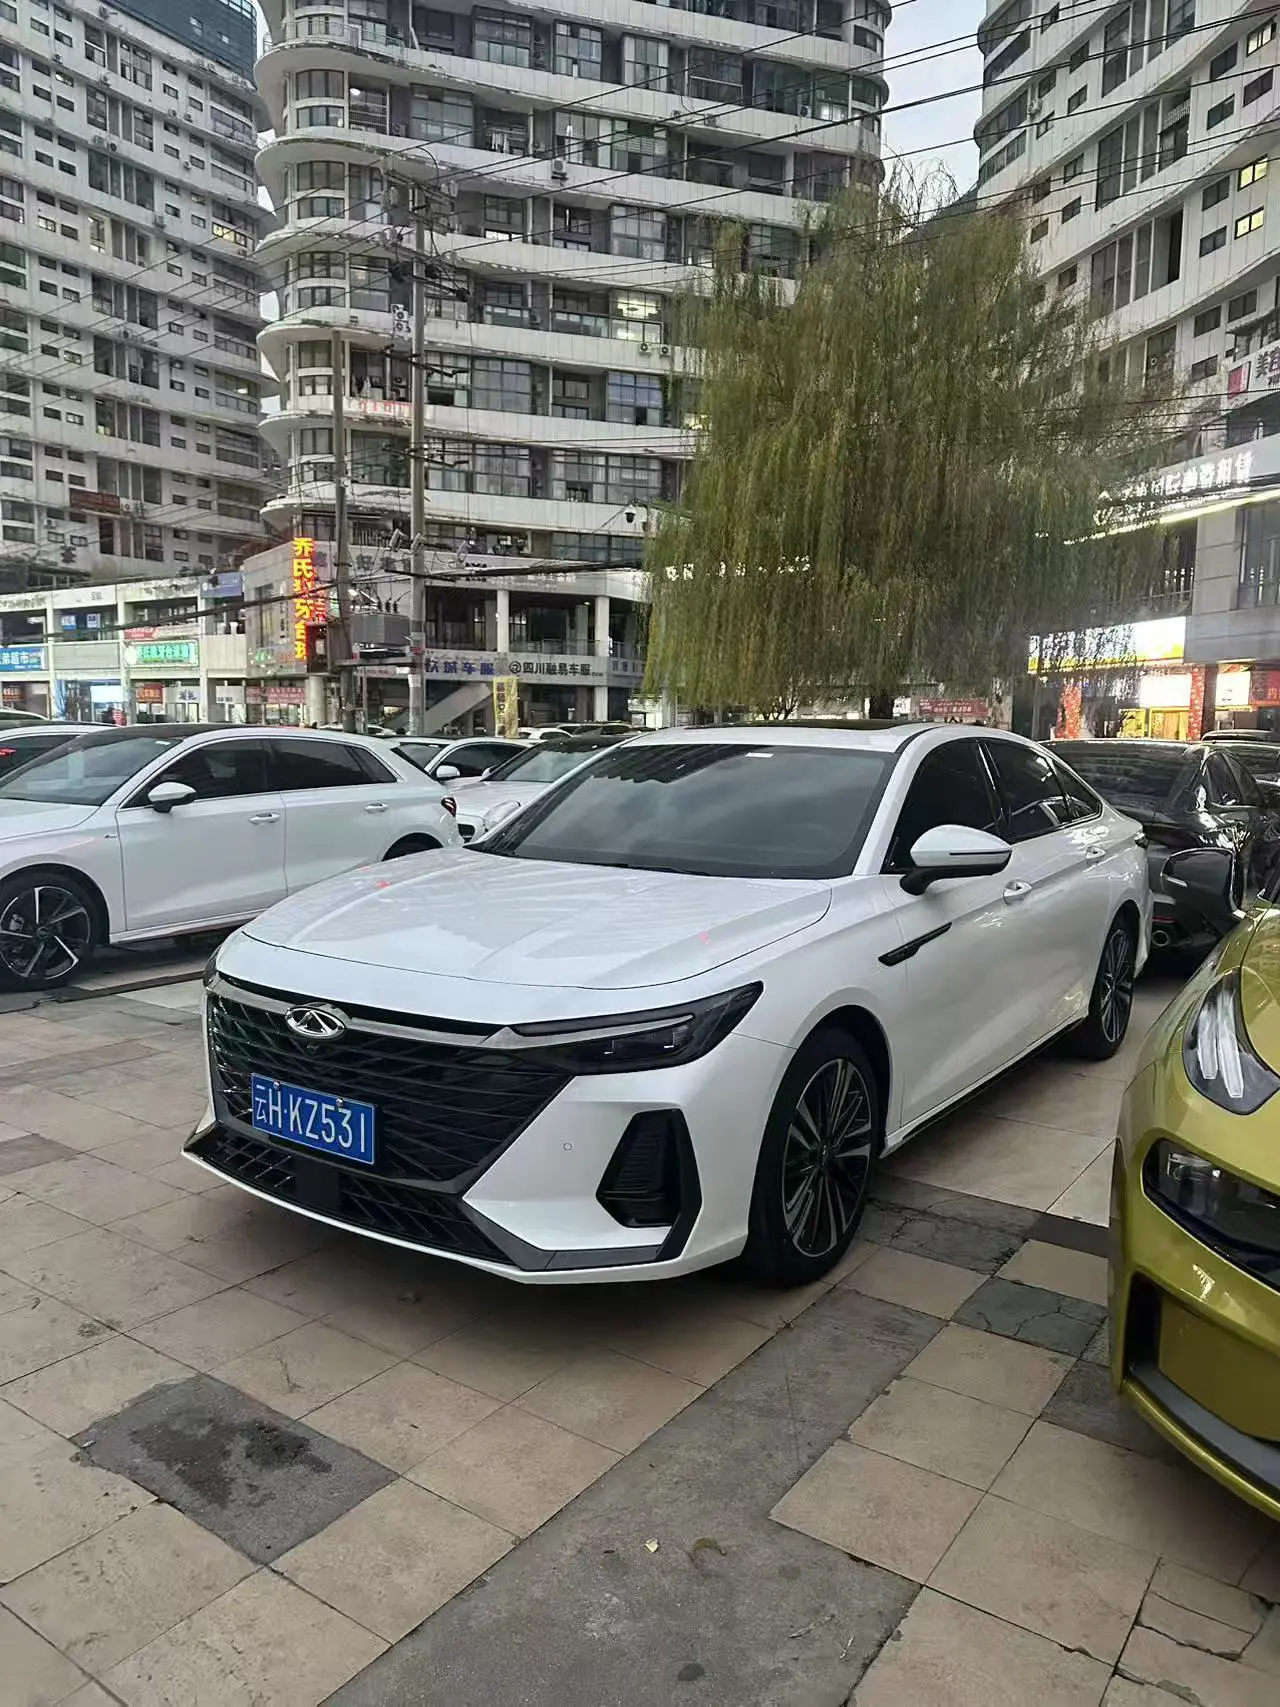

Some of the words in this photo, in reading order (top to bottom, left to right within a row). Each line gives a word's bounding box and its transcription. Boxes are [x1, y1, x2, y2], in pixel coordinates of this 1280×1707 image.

[523, 661, 591, 677] 四川融易车服
[255, 1085, 365, 1153] 云H·KZ531
